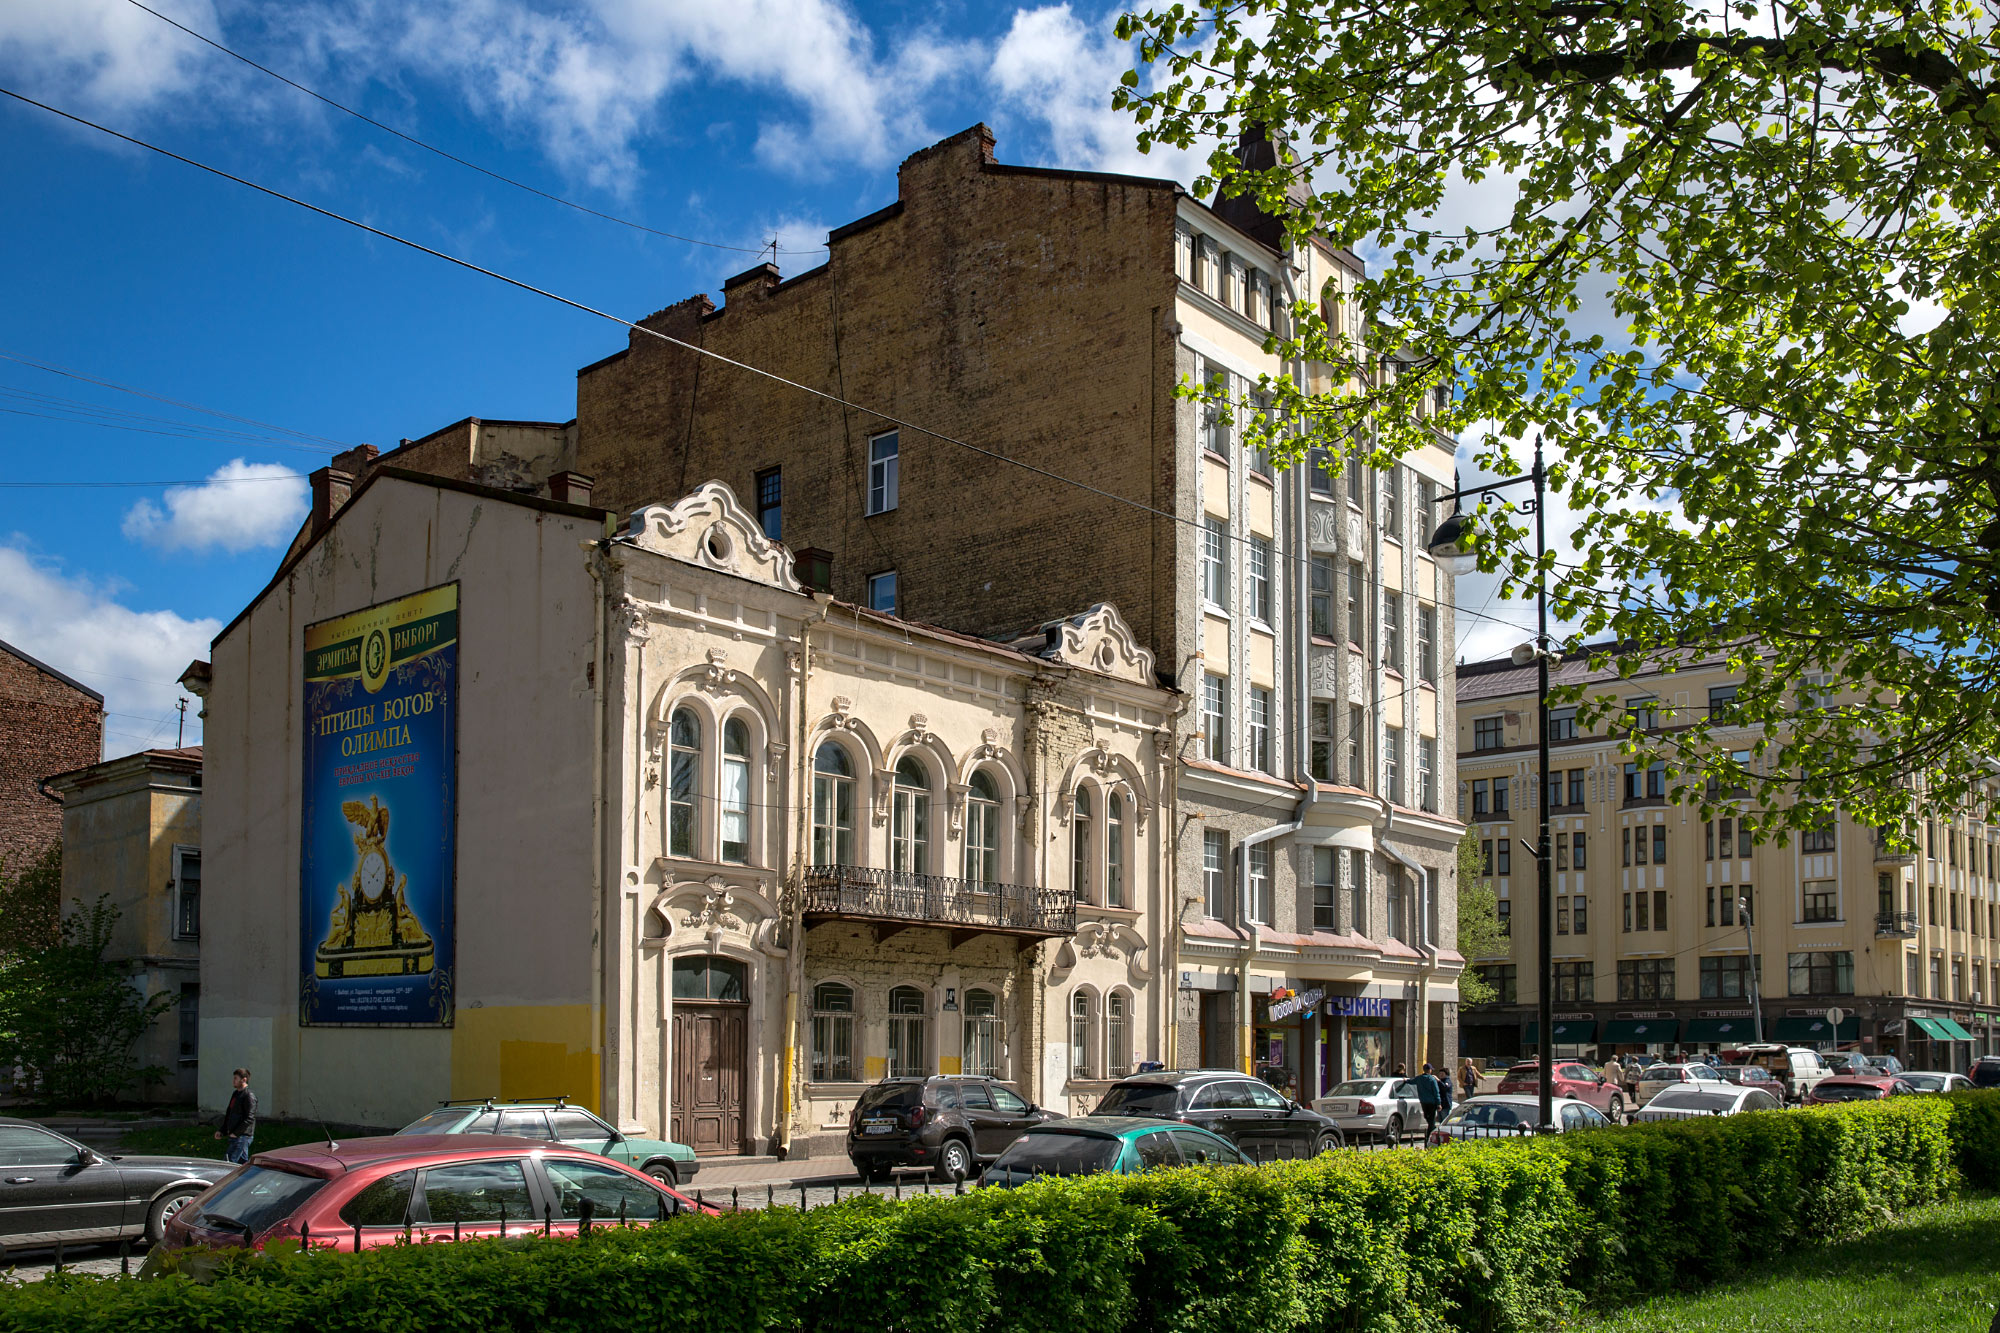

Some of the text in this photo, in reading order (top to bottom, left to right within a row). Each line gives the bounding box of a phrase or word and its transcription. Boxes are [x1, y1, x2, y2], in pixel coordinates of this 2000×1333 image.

[331, 607, 423, 640] ВЫСТАВОЧНЫЙ ЦЕНТР
[317, 621, 439, 672] ЭРМИТАЖ ВЫБОРГ
[320, 691, 434, 736] ПТИЦЫ БОГОВ
[341, 724, 412, 757] ОЛИМПА
[334, 752, 421, 777] ПРИКЛАДНОЕ ИСКУССТВО
[393, 765, 415, 777] ВЕКОВ
[1271, 988, 1323, 1021] 1000 И ОДНА
[1330, 997, 1391, 1016] СУМКА
